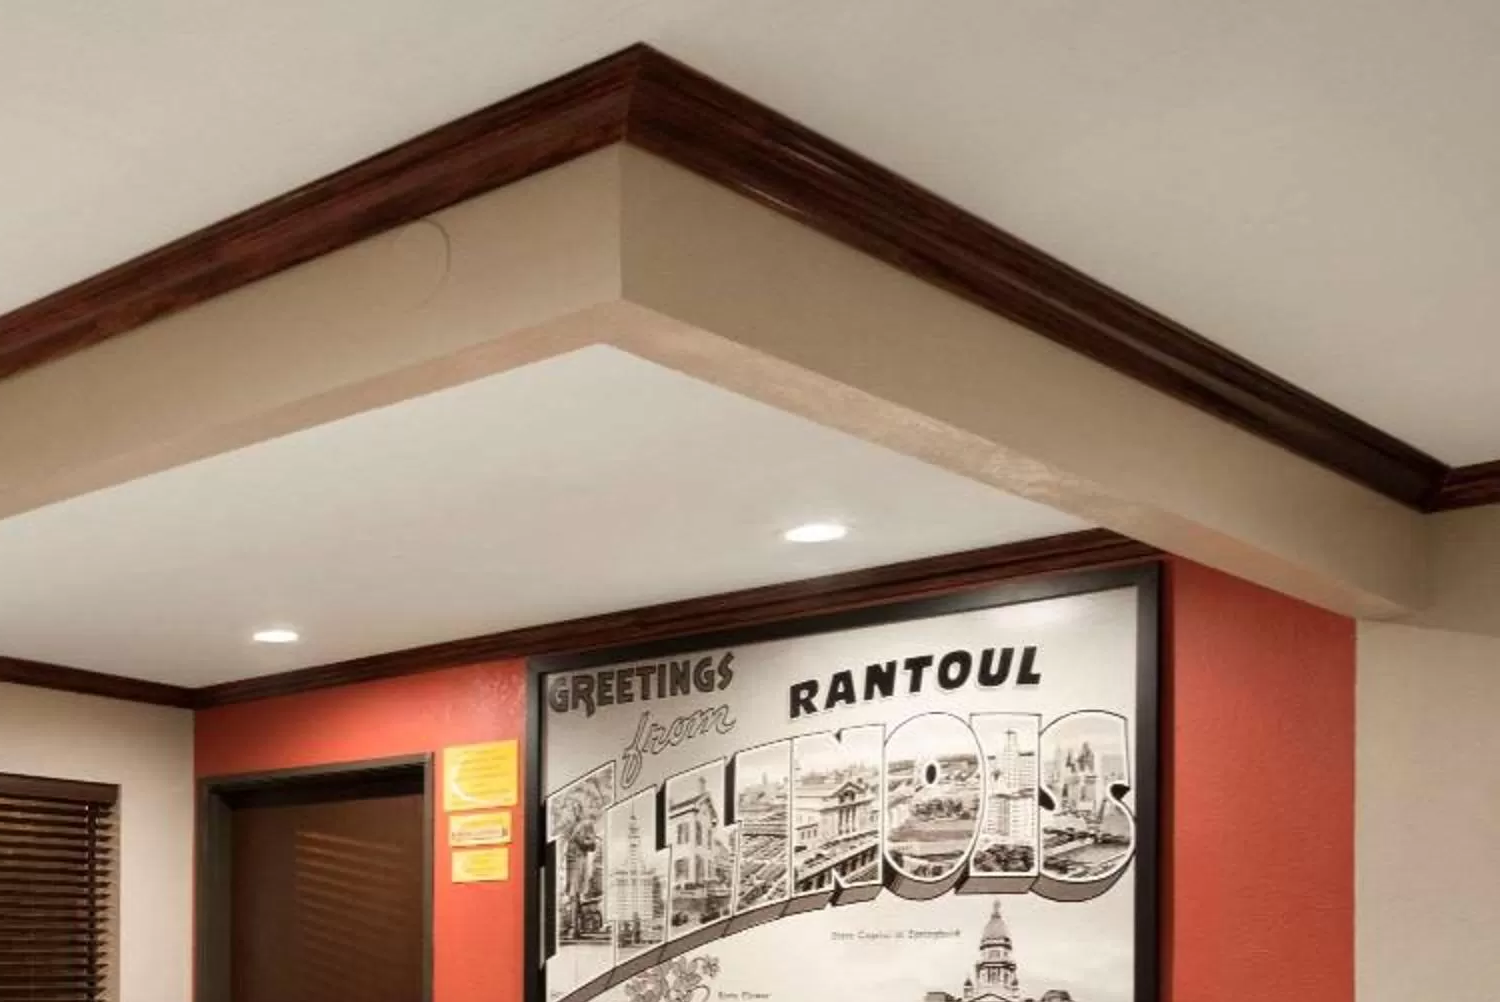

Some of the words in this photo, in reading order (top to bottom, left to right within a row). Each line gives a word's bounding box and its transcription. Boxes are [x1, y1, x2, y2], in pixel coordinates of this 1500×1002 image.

[549, 652, 734, 718] GREETINGS
[789, 646, 1042, 719] RANTOUL
[620, 704, 736, 790] from
